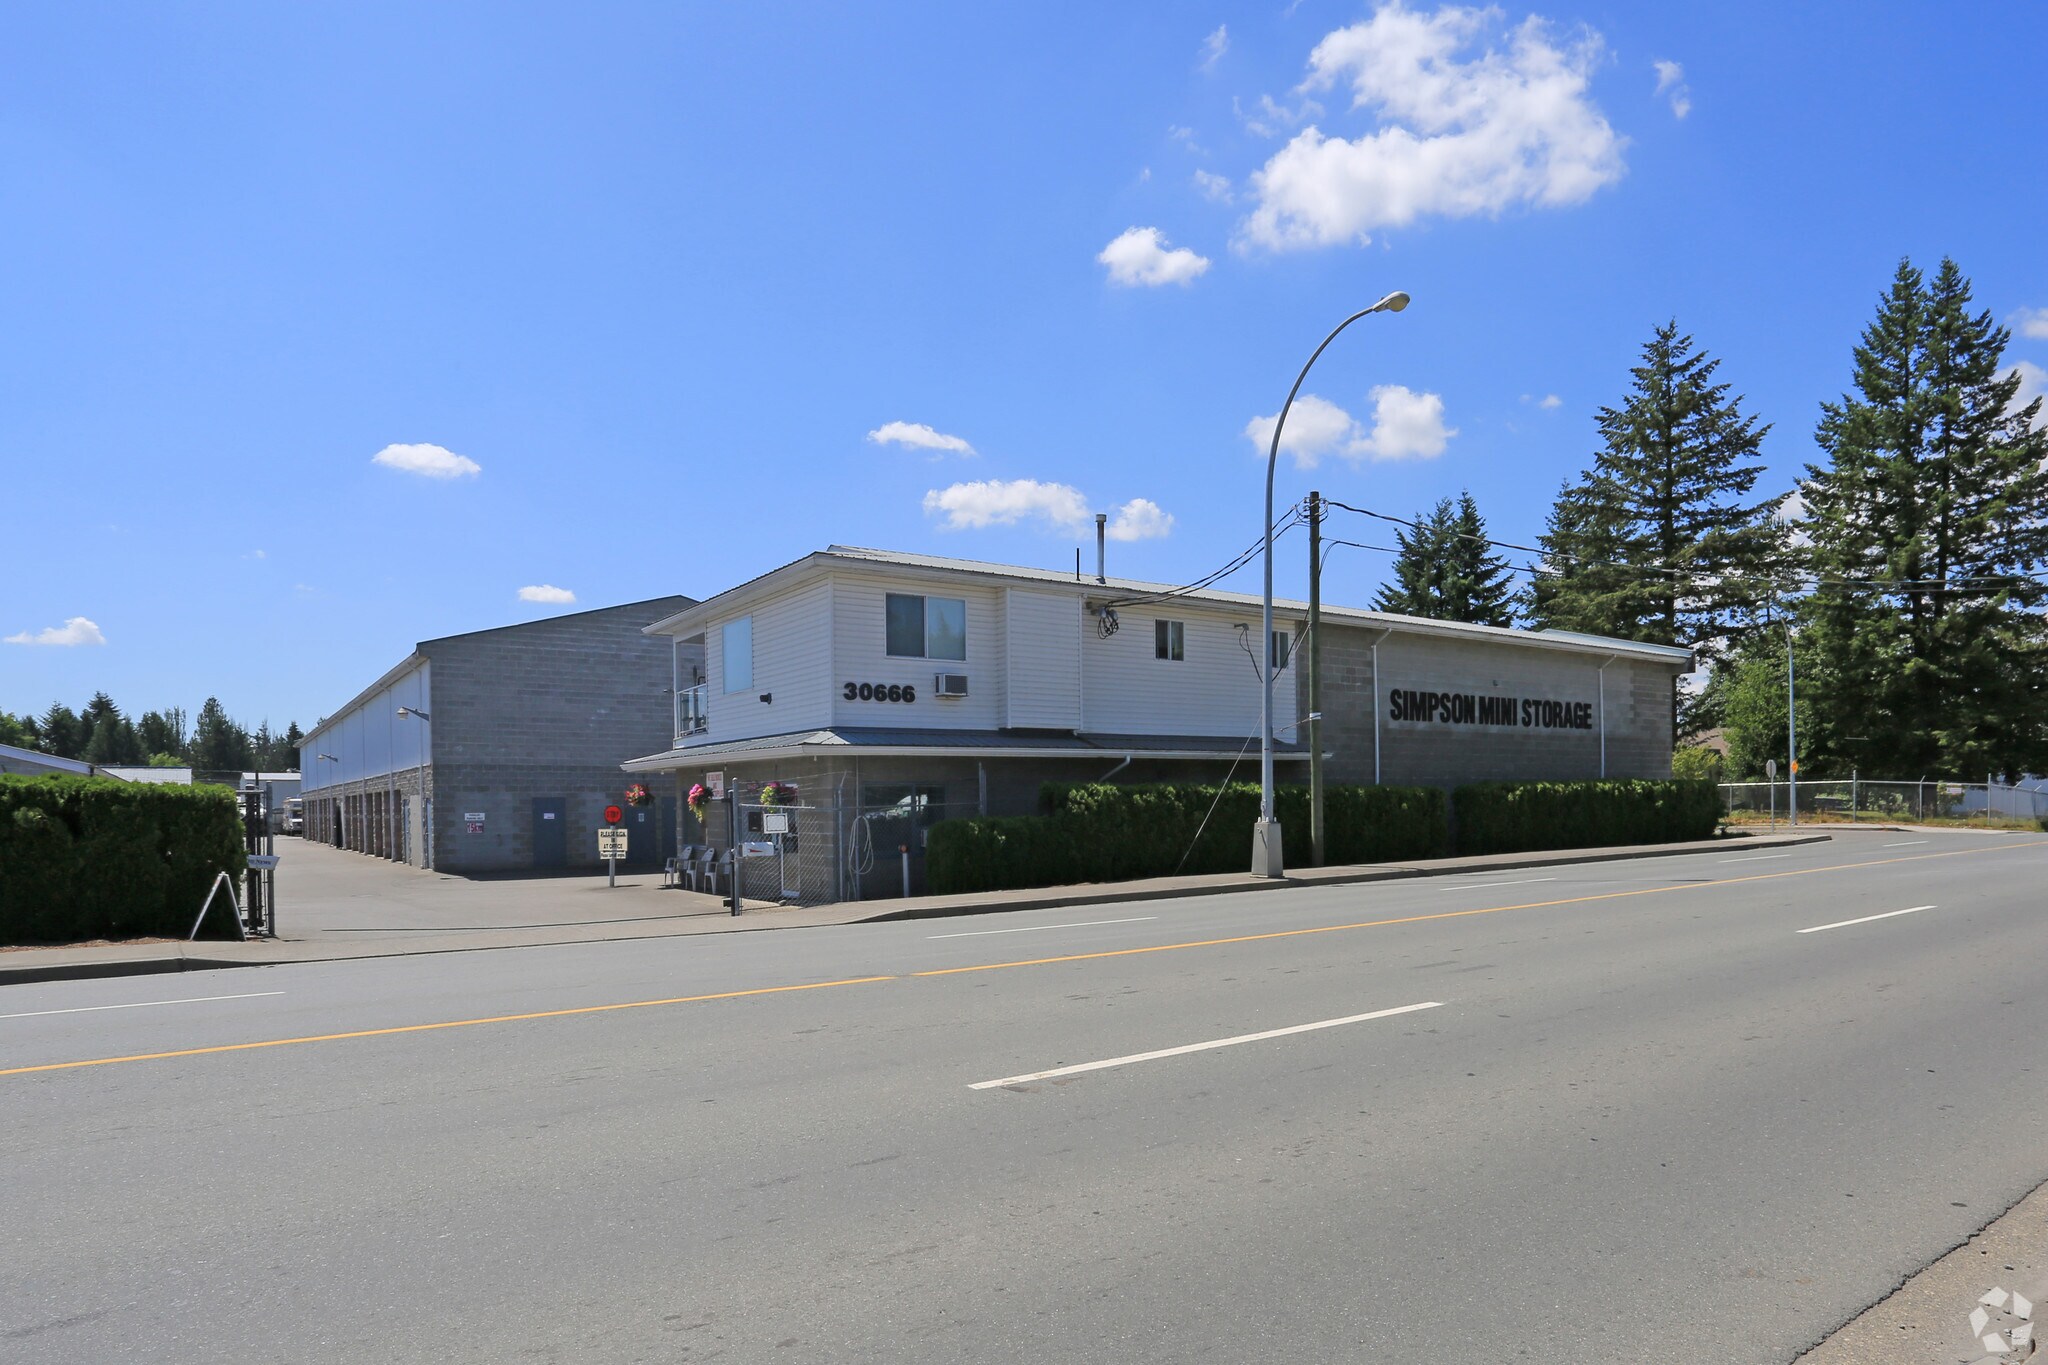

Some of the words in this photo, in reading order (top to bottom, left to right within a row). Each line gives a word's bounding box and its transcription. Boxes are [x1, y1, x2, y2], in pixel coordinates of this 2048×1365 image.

[843, 682, 916, 703] 30666
[1390, 688, 1475, 724] SIMPSON
[1479, 695, 1518, 726] MINI
[1521, 698, 1592, 730] STORAGE
